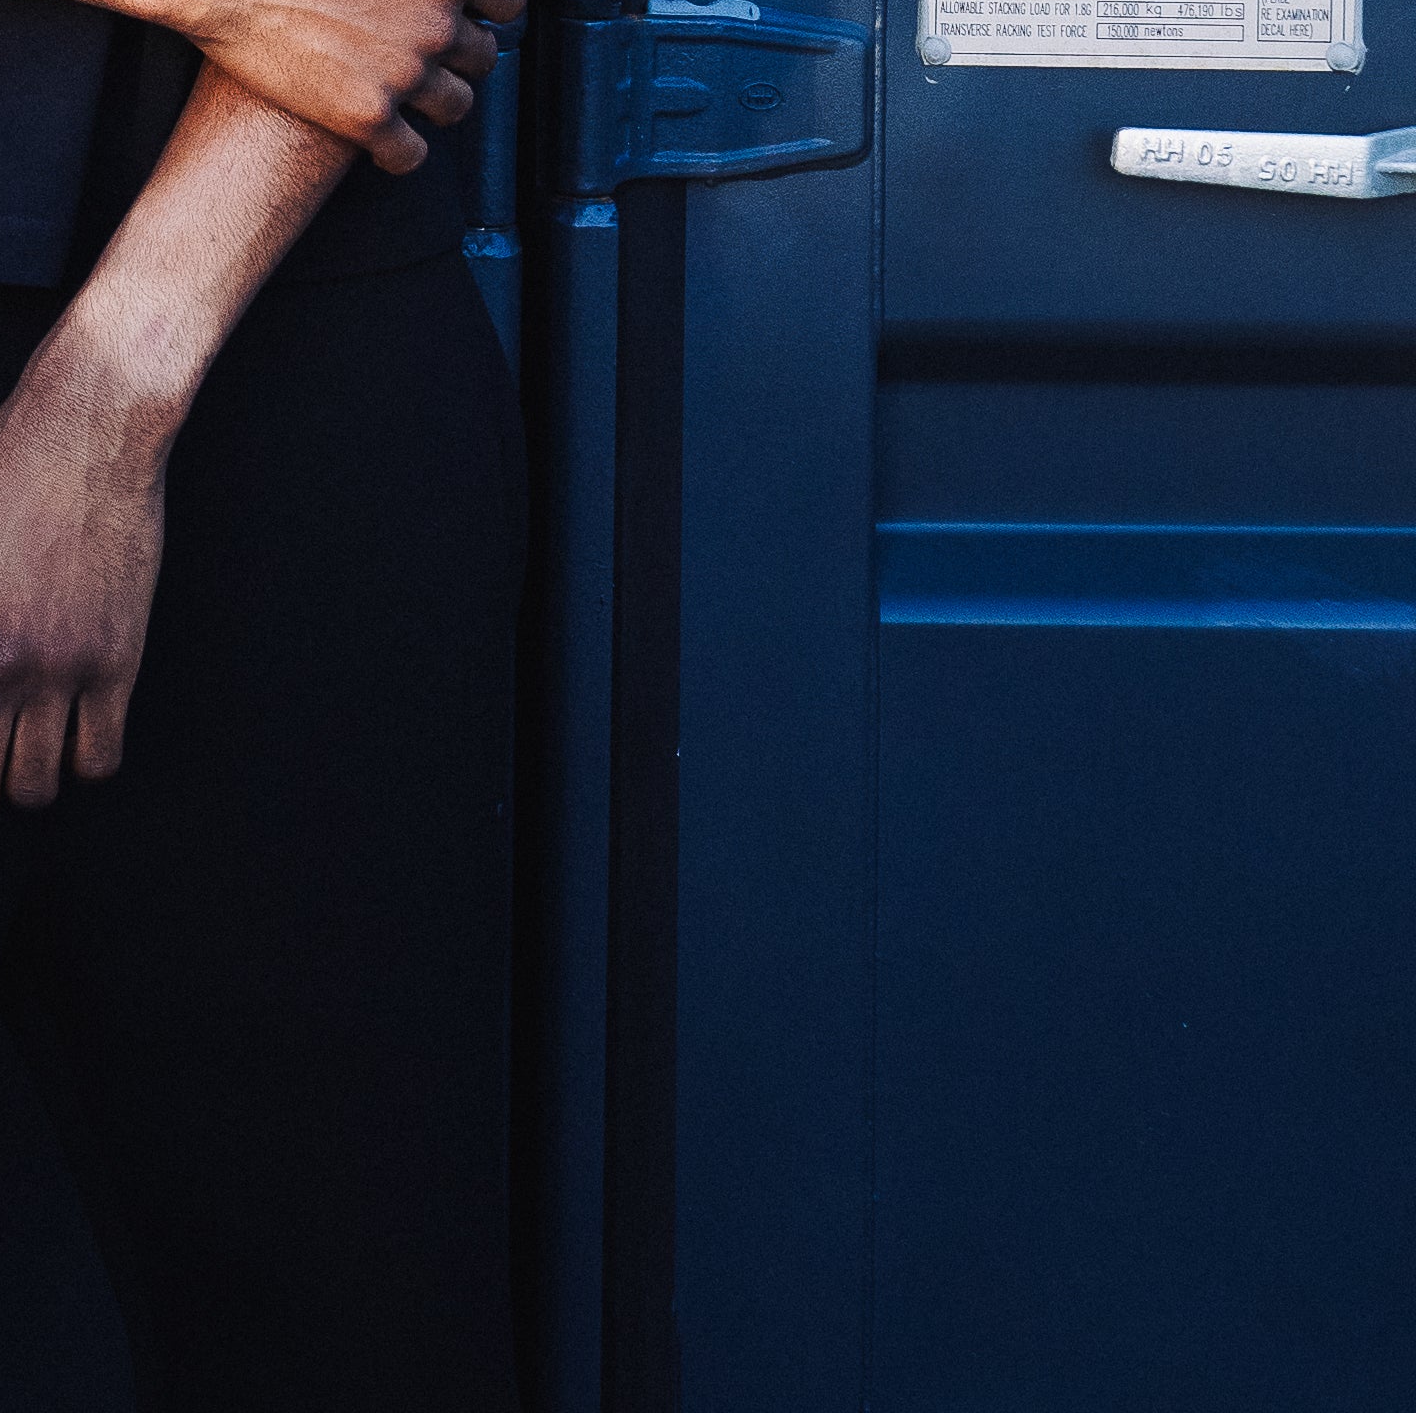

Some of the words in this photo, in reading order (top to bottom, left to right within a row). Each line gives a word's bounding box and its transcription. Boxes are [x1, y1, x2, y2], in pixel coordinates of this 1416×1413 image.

[940, 1, 984, 15] ALLOWABLE
[988, 2, 1026, 15] STACKING
[1030, 3, 1050, 16] LOAD
[1055, 3, 1070, 16] FOR
[1146, 4, 1162, 16] kg
[1220, 4, 1243, 17] lbs
[940, 23, 992, 37] TRANSVERSE
[996, 24, 1032, 37] RACKING
[1037, 24, 1056, 37] TEST
[1061, 25, 1087, 38] FORCE
[1144, 25, 1184, 38] newtons
